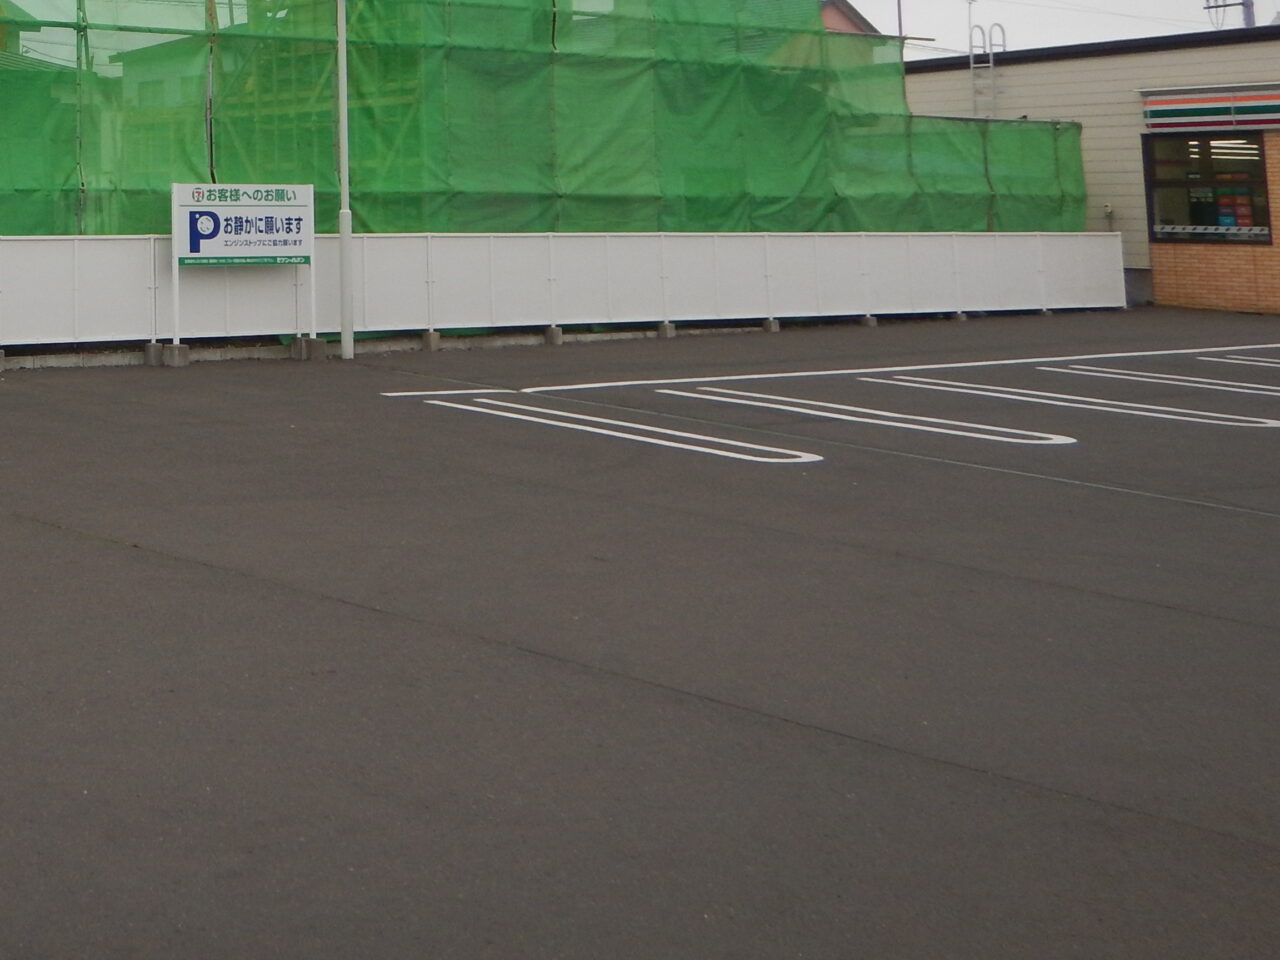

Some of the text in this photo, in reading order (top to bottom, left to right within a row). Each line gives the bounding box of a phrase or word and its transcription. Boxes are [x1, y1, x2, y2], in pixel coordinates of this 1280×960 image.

[206, 188, 297, 202] お客様へのお願い
[189, 211, 221, 253] P
[223, 216, 303, 236] お静かに願います
